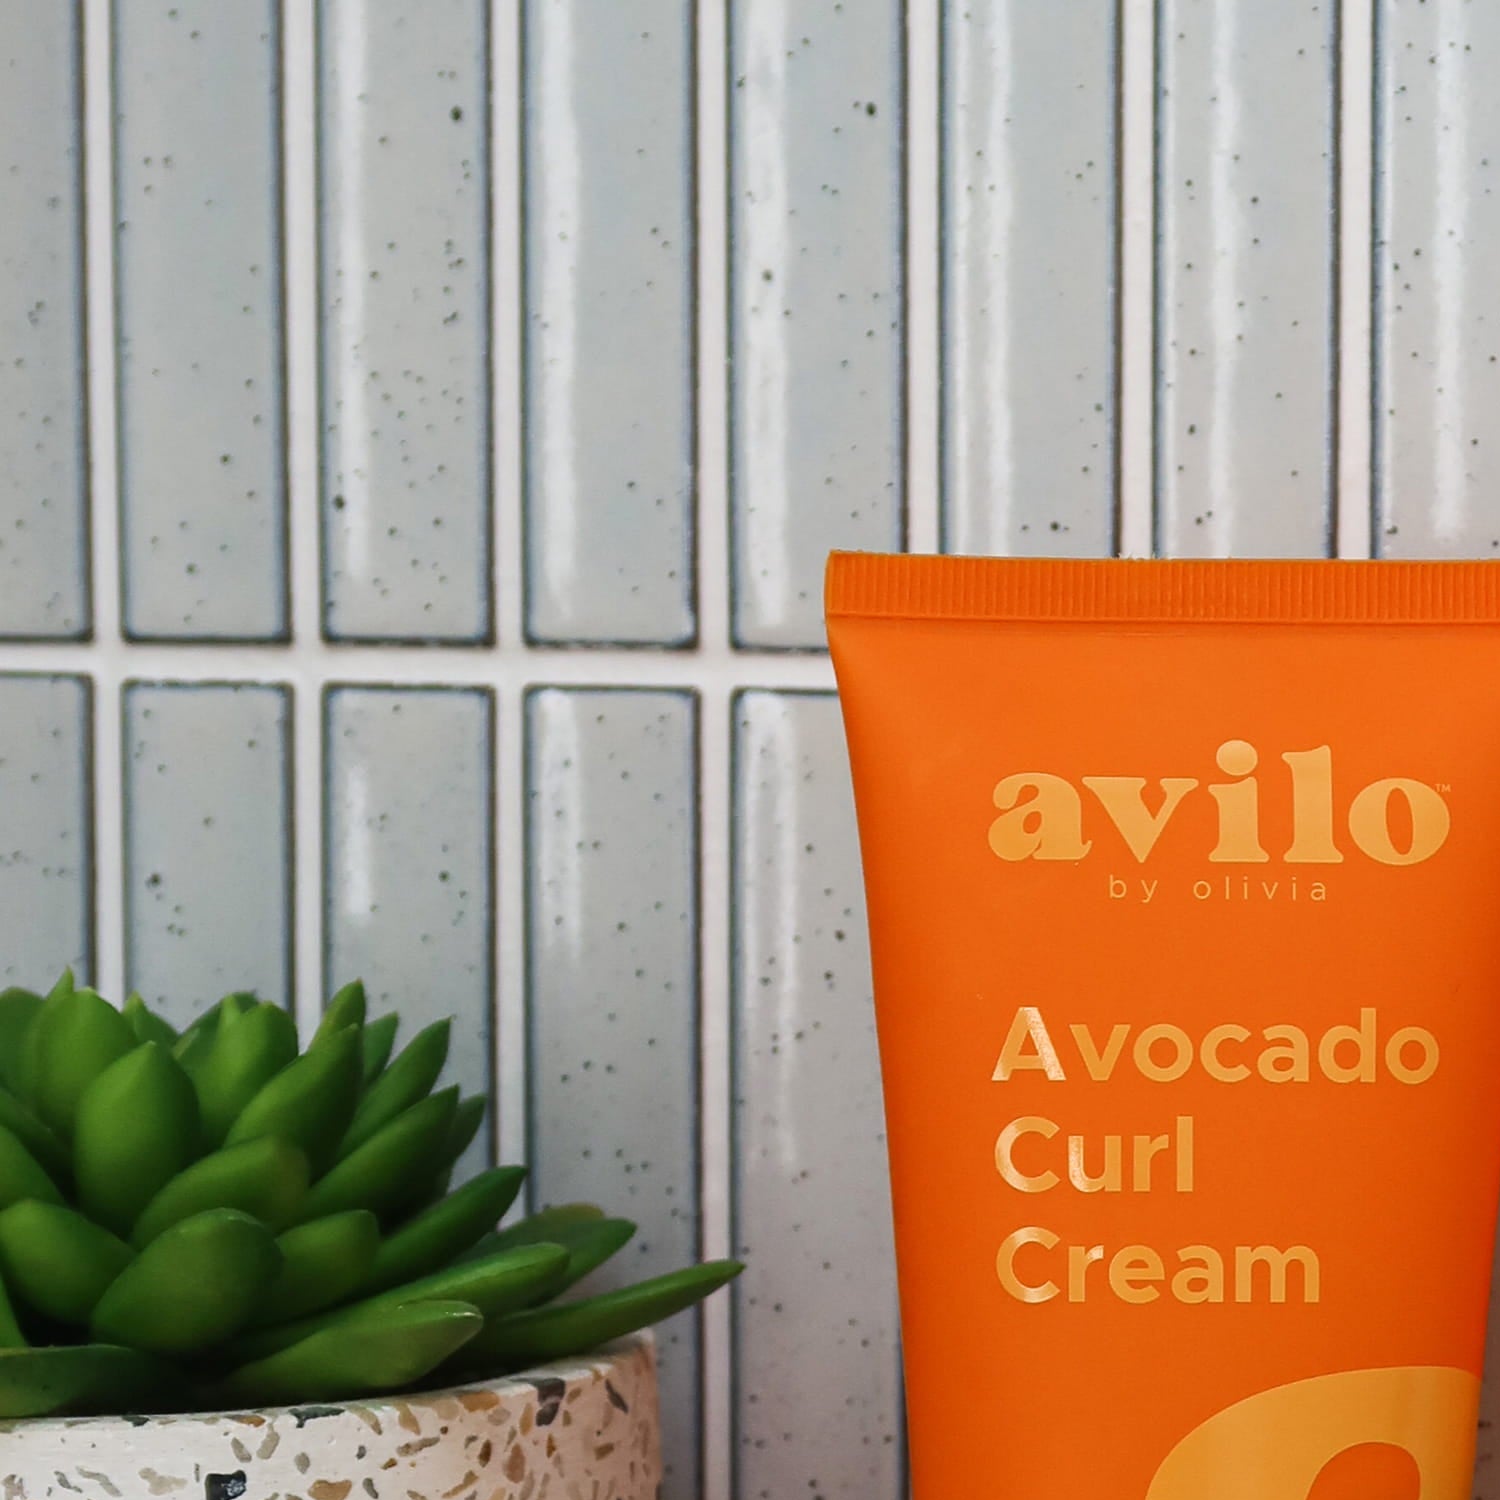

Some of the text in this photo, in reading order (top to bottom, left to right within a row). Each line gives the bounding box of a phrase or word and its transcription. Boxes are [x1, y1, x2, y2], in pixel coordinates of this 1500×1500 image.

[988, 739, 1451, 866] avilo
[1109, 873, 1327, 903] by olivia
[991, 1006, 1440, 1085] Avocado
[994, 1115, 1194, 1193] Curl
[995, 1226, 1321, 1304] Cream
